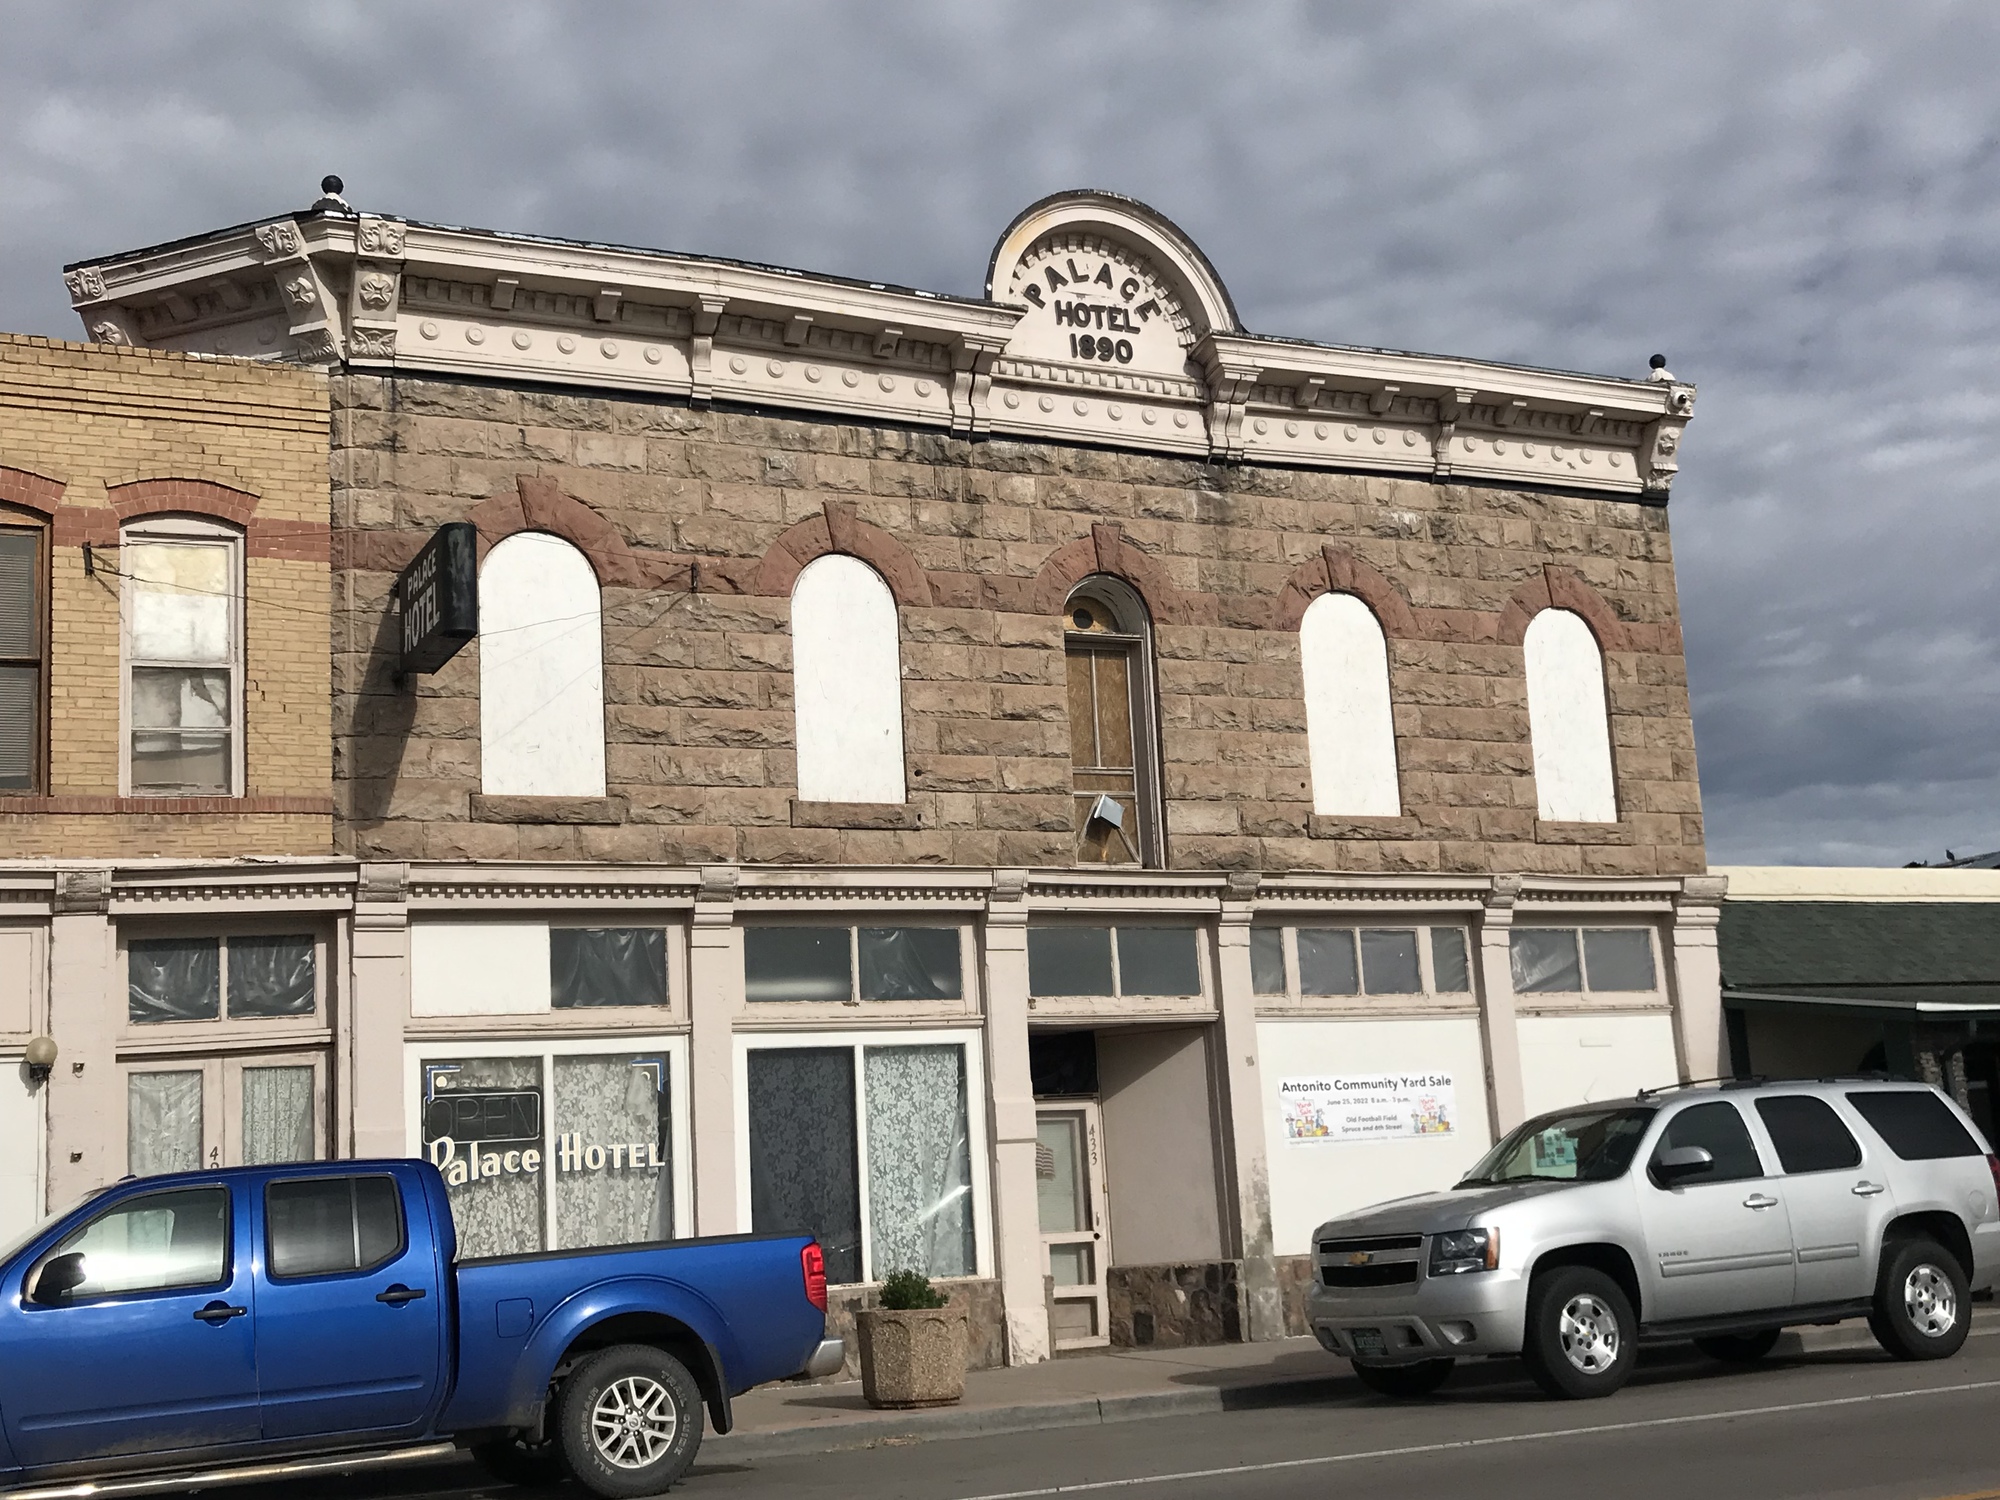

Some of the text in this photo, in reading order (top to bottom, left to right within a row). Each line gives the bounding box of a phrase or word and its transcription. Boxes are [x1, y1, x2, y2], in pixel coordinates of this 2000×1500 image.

[1022, 257, 1162, 323] PALACE
[1054, 299, 1141, 335] HOTEL
[1069, 333, 1134, 364] 1890
[407, 547, 437, 600] PALACE
[403, 581, 441, 655] HOTEL
[1281, 1075, 1452, 1093] Antonito Community Yard Sale
[428, 1096, 535, 1138] OPEN
[1341, 1126, 1361, 1134] Spruce
[429, 1136, 541, 1187] Palace
[1088, 1123, 1098, 1166] 433
